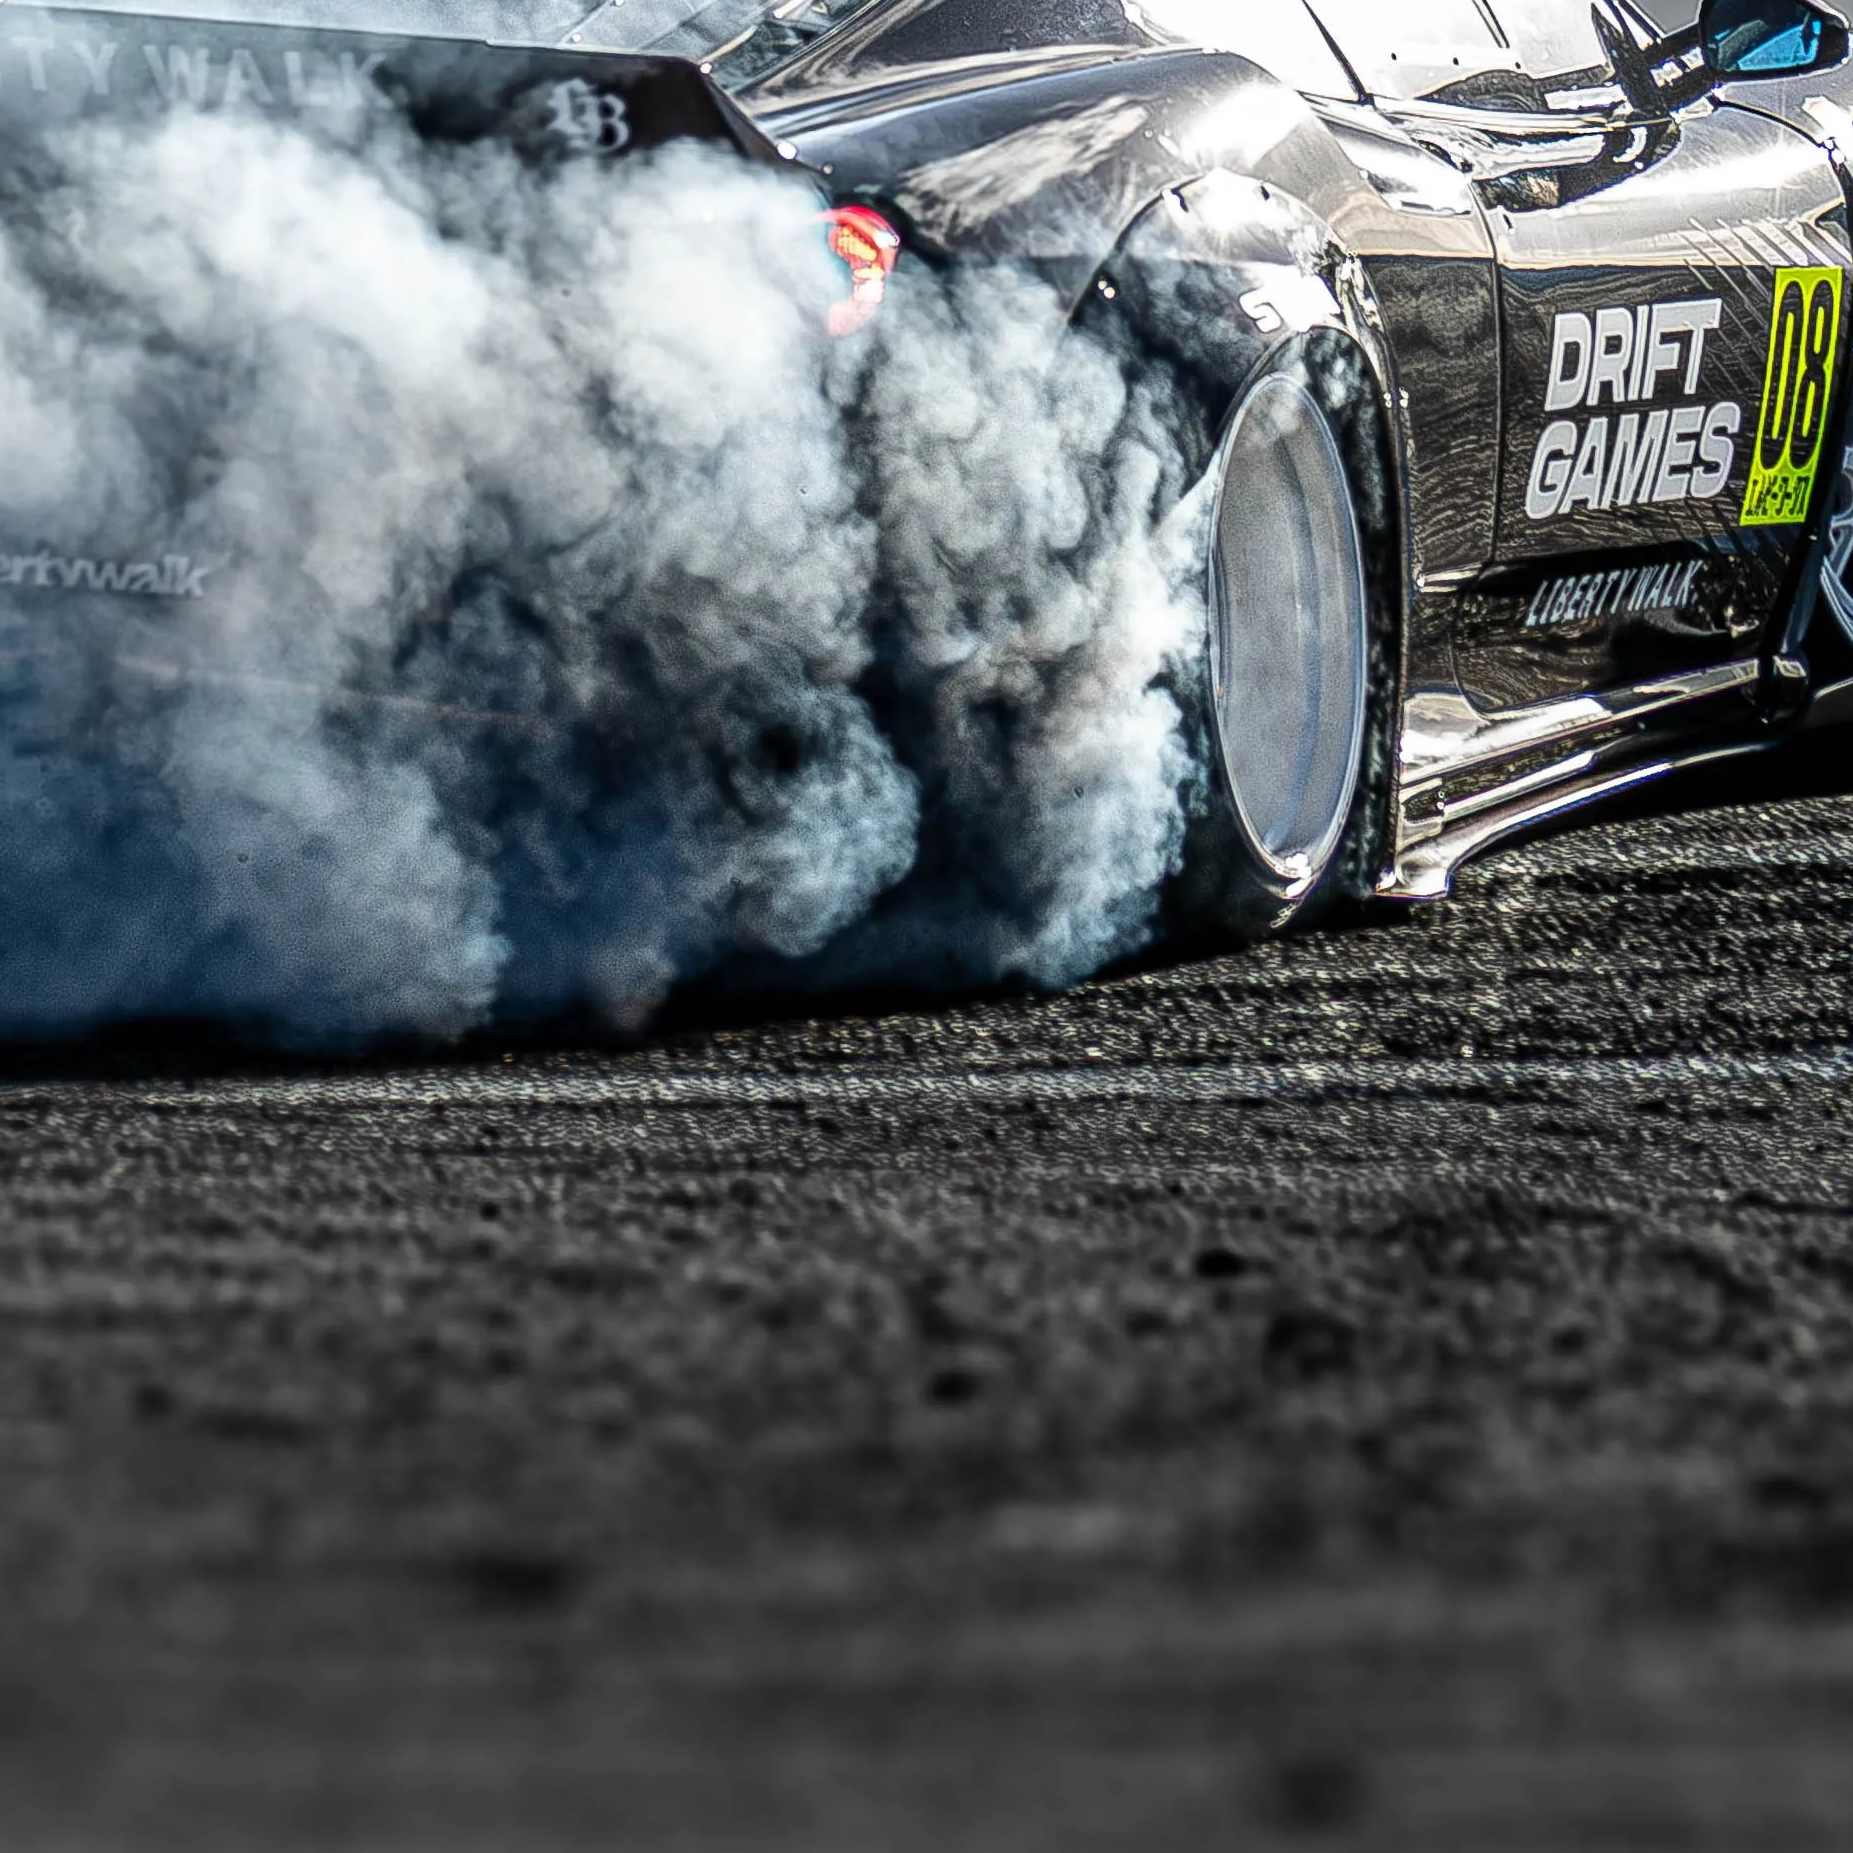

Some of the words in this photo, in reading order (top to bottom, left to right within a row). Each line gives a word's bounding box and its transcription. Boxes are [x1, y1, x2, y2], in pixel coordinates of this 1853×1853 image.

[1544, 297, 1723, 411] DRIFT
[1758, 279, 1836, 472] 08
[1523, 400, 1742, 520] GAMES
[1525, 567, 1638, 627] LIBERTY
